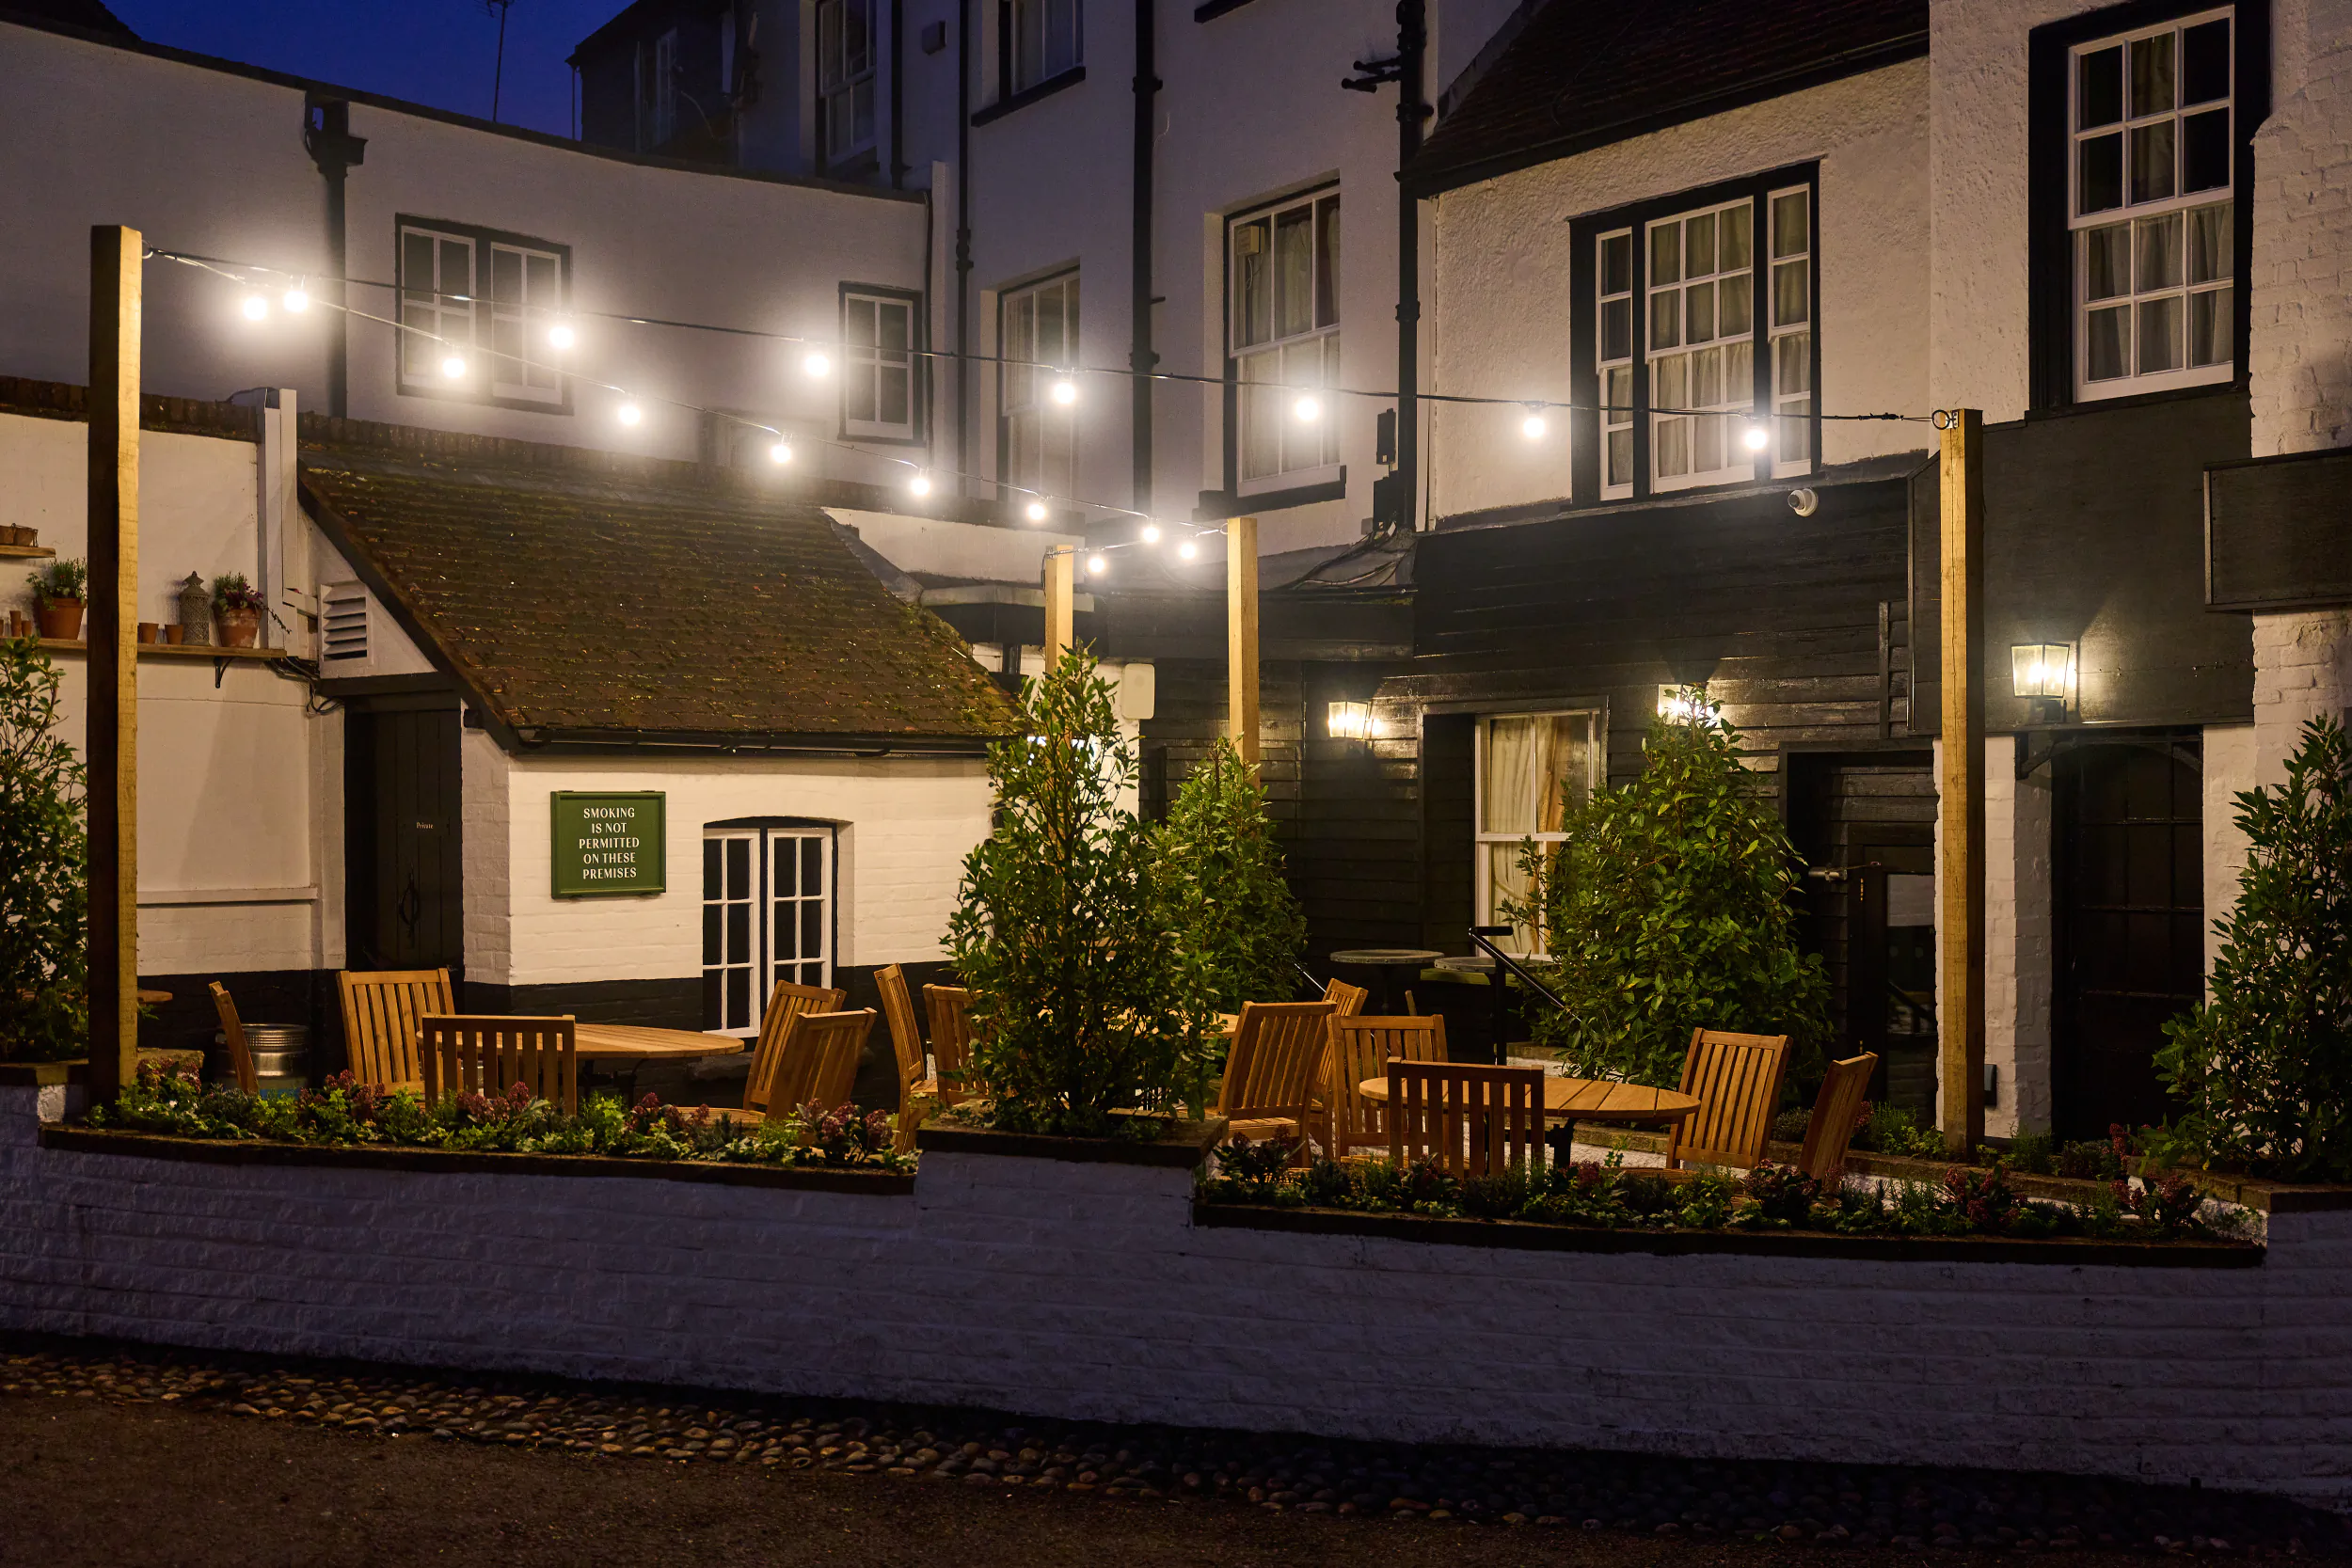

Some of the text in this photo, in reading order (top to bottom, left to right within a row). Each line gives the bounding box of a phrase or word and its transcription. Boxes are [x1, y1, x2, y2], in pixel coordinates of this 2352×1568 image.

[583, 807, 635, 818] SMOKING
[592, 822, 627, 833] IS NOT
[579, 837, 640, 849] PERMITTED
[583, 852, 636, 863] ON THESE
[582, 867, 637, 879] PREMISES
